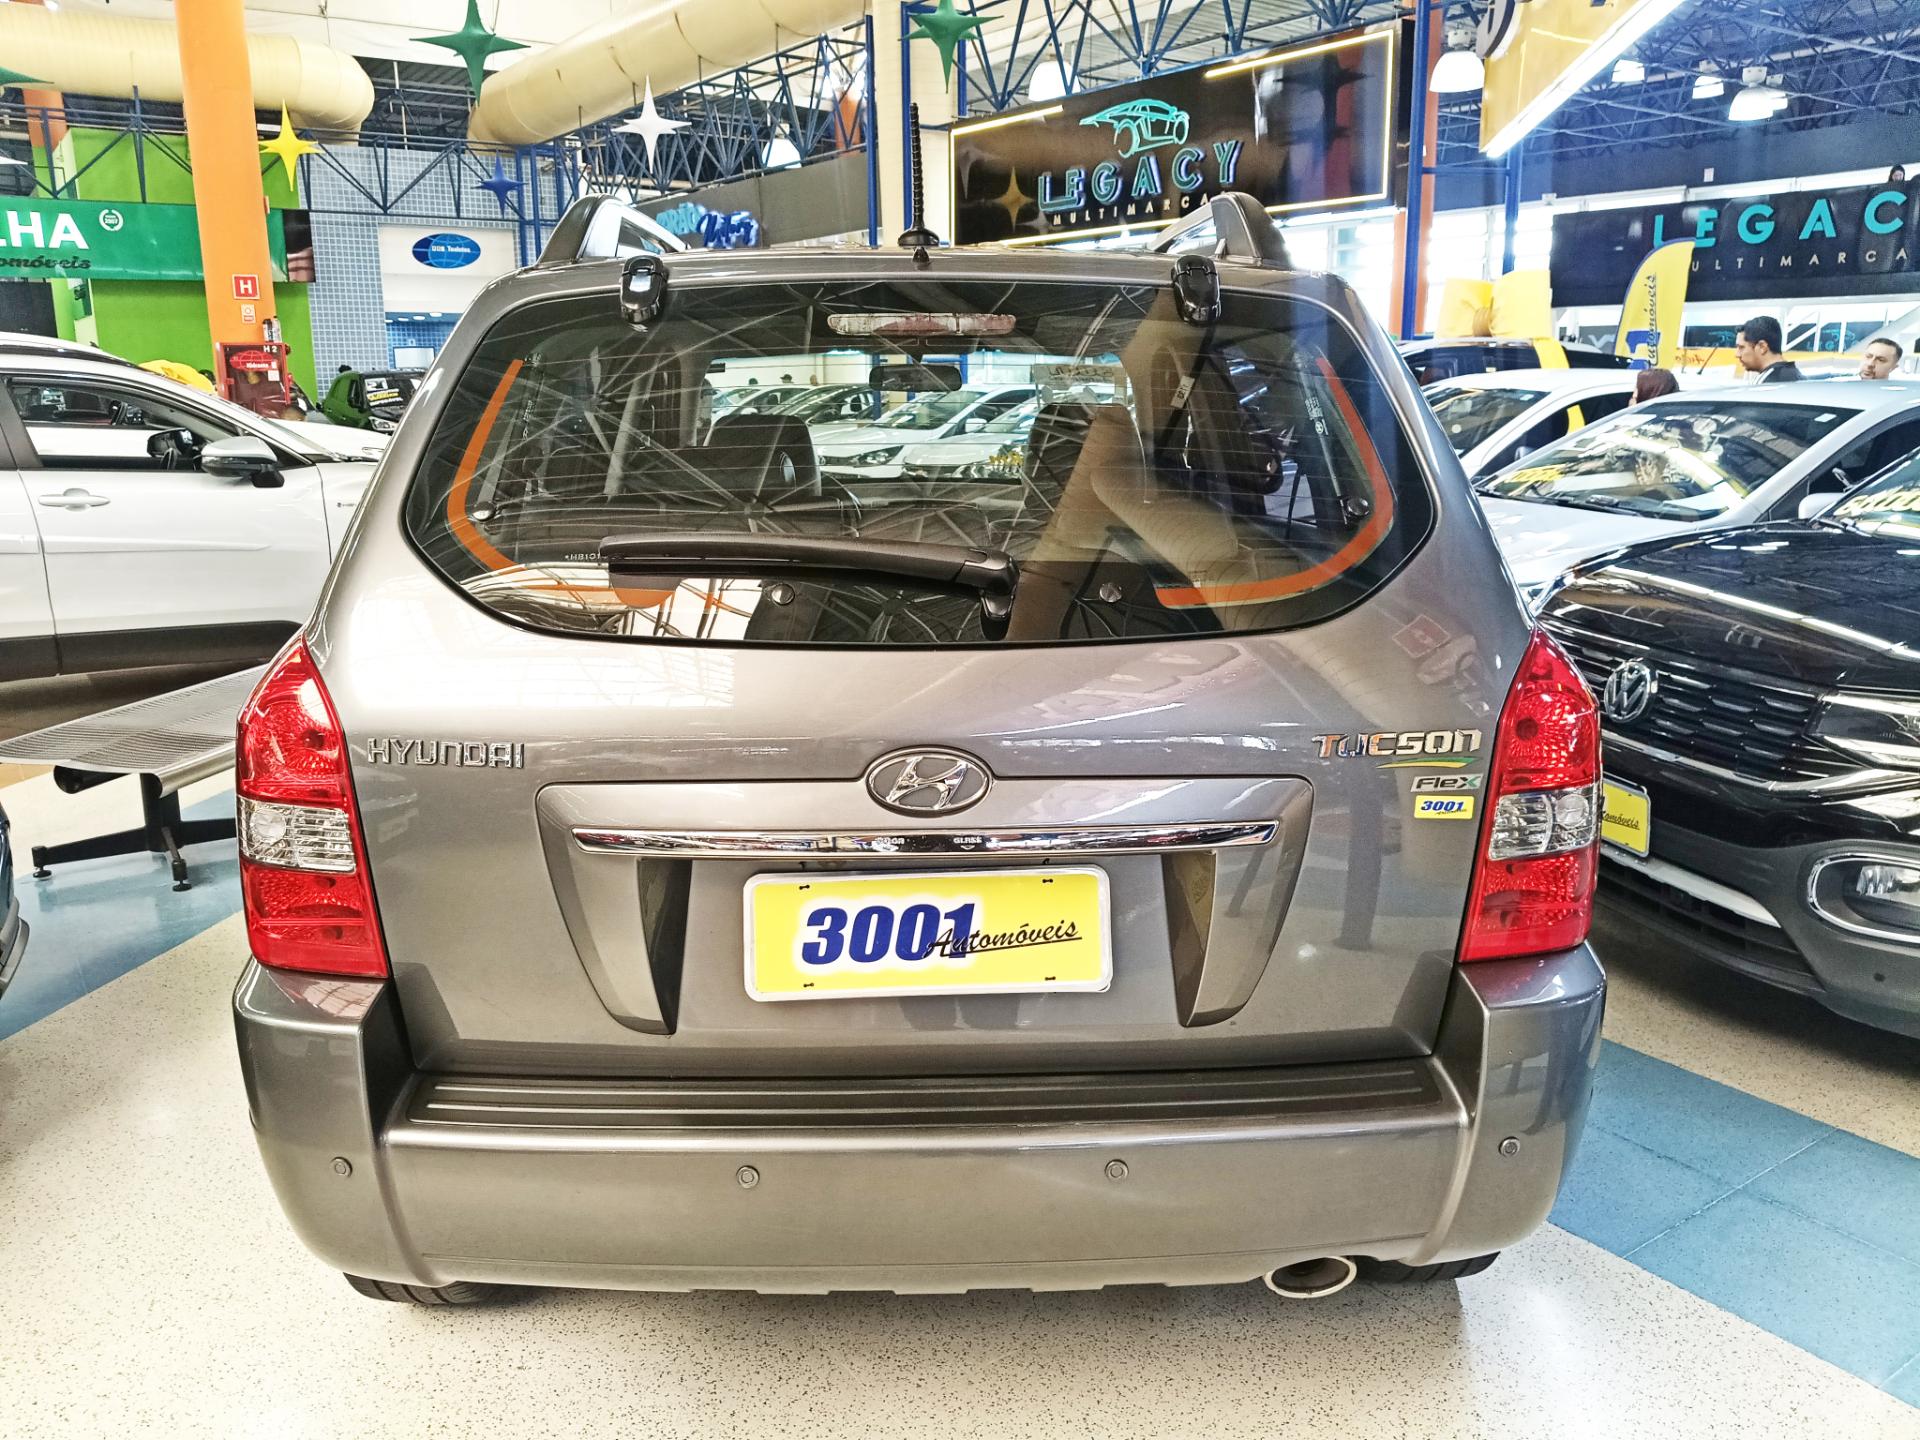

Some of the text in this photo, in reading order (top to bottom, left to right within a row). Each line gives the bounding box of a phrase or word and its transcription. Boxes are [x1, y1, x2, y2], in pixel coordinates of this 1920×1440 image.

[1037, 140, 1245, 213] LEGACY
[1052, 191, 1226, 226] MULTIMARCA
[0, 210, 90, 250] HA
[1691, 248, 1908, 272] ULTIMARCA
[240, 279, 253, 295] H
[367, 737, 525, 769] HYUNDAI
[1311, 729, 1483, 758] TUCSON
[1415, 775, 1481, 790] Flex
[1421, 800, 1464, 811] 3001
[801, 903, 1083, 966] 3001 Automóveis
